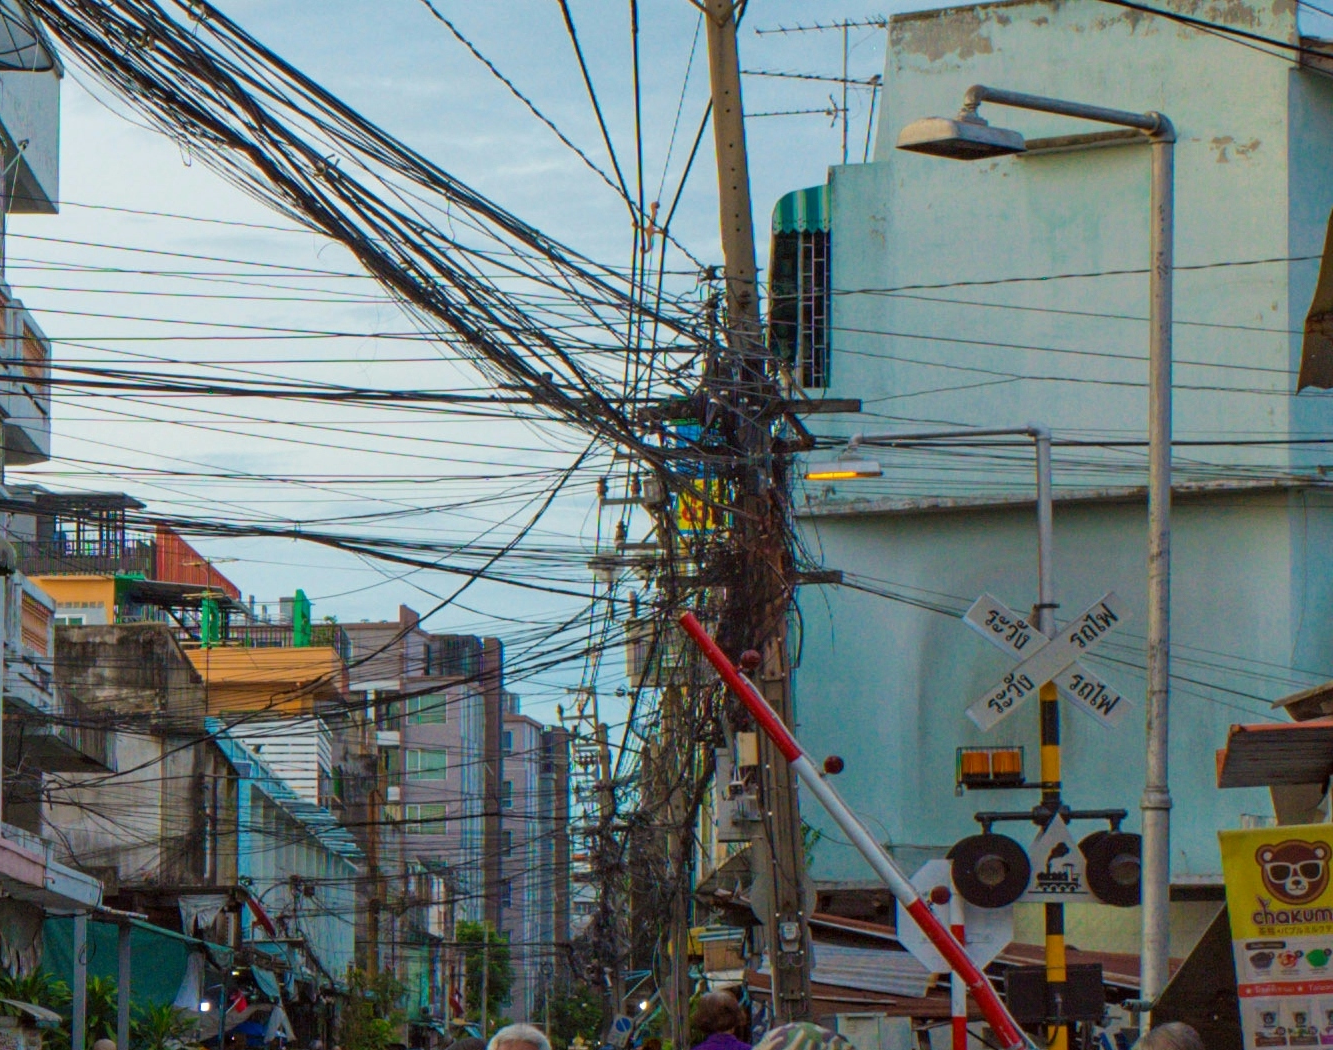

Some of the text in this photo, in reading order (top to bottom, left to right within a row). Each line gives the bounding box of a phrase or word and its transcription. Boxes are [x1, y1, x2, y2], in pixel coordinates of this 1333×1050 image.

[985, 610, 1031, 650] ระวัง
[1070, 603, 1119, 648] รถไฟ
[988, 673, 1034, 713] ระวัง
[1069, 674, 1120, 715] รถไฟ
